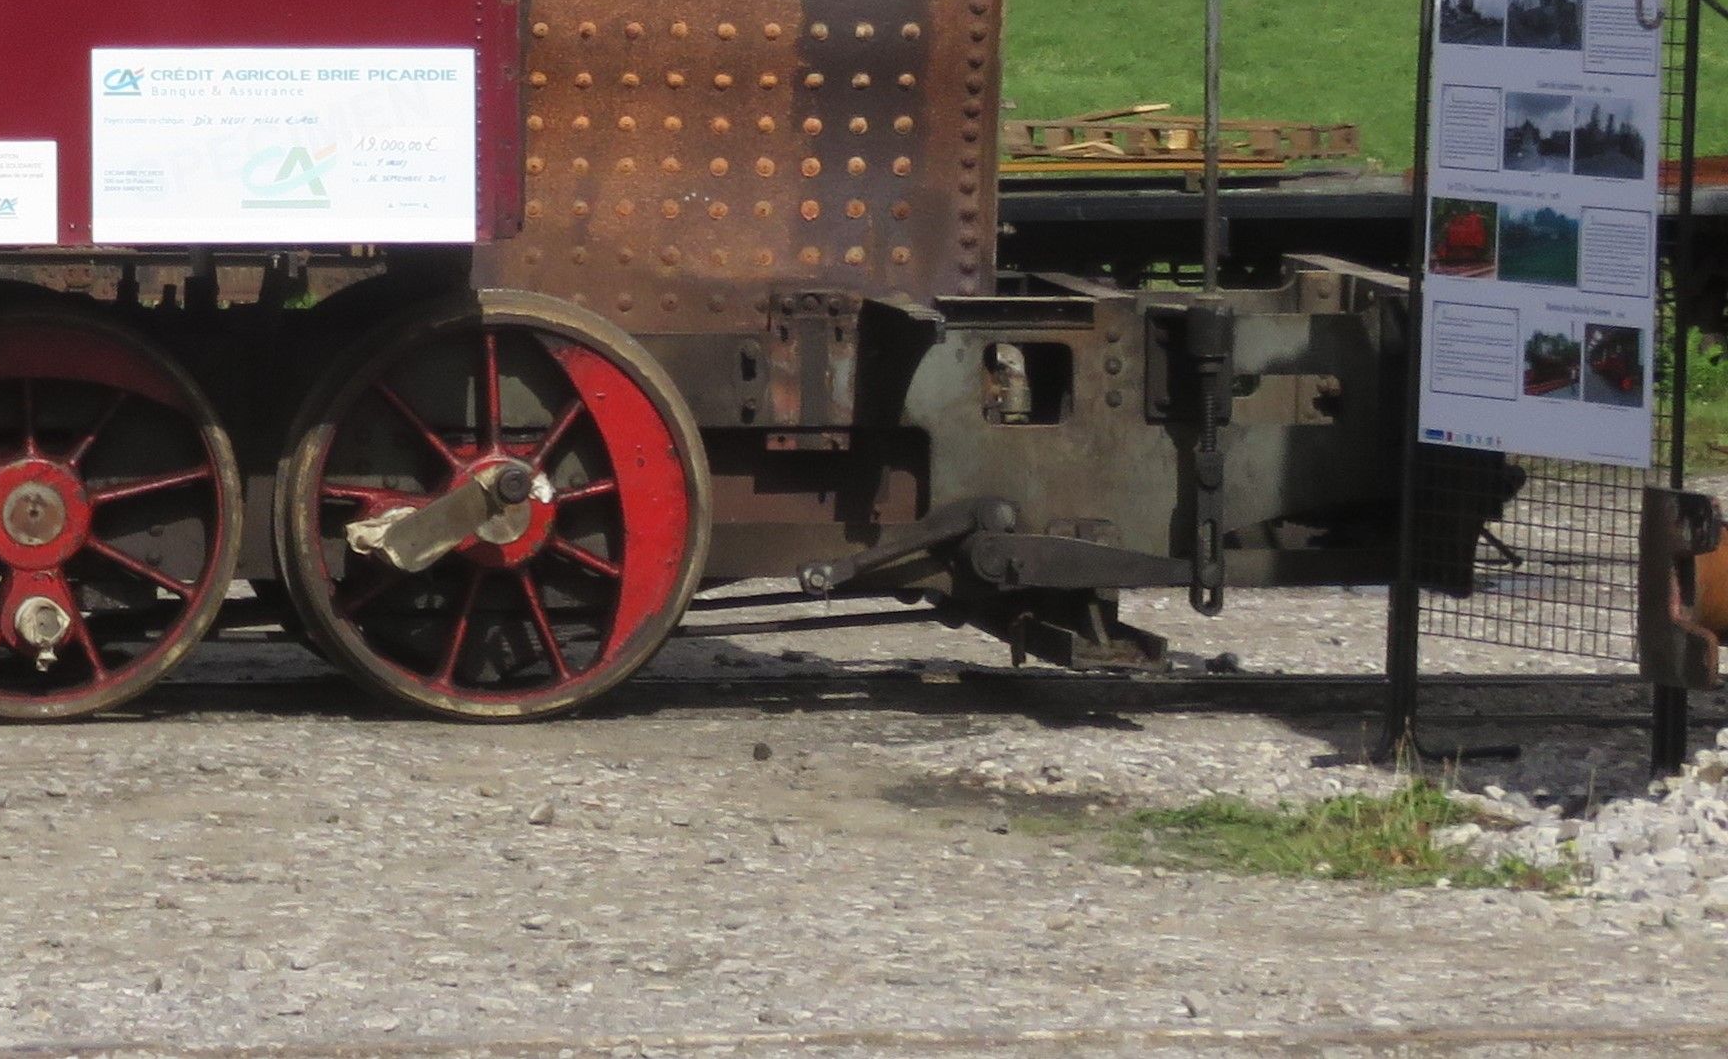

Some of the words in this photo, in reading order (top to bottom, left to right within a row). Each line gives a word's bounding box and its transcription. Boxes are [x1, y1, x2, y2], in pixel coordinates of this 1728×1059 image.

[150, 66, 214, 82] CRÉDIT
[222, 68, 312, 82] AGRICOLE
[317, 68, 360, 82] BRIE
[367, 68, 457, 82] PICARDIE
[151, 85, 205, 98] Banque
[211, 85, 221, 96] &
[229, 86, 304, 97] Assurance
